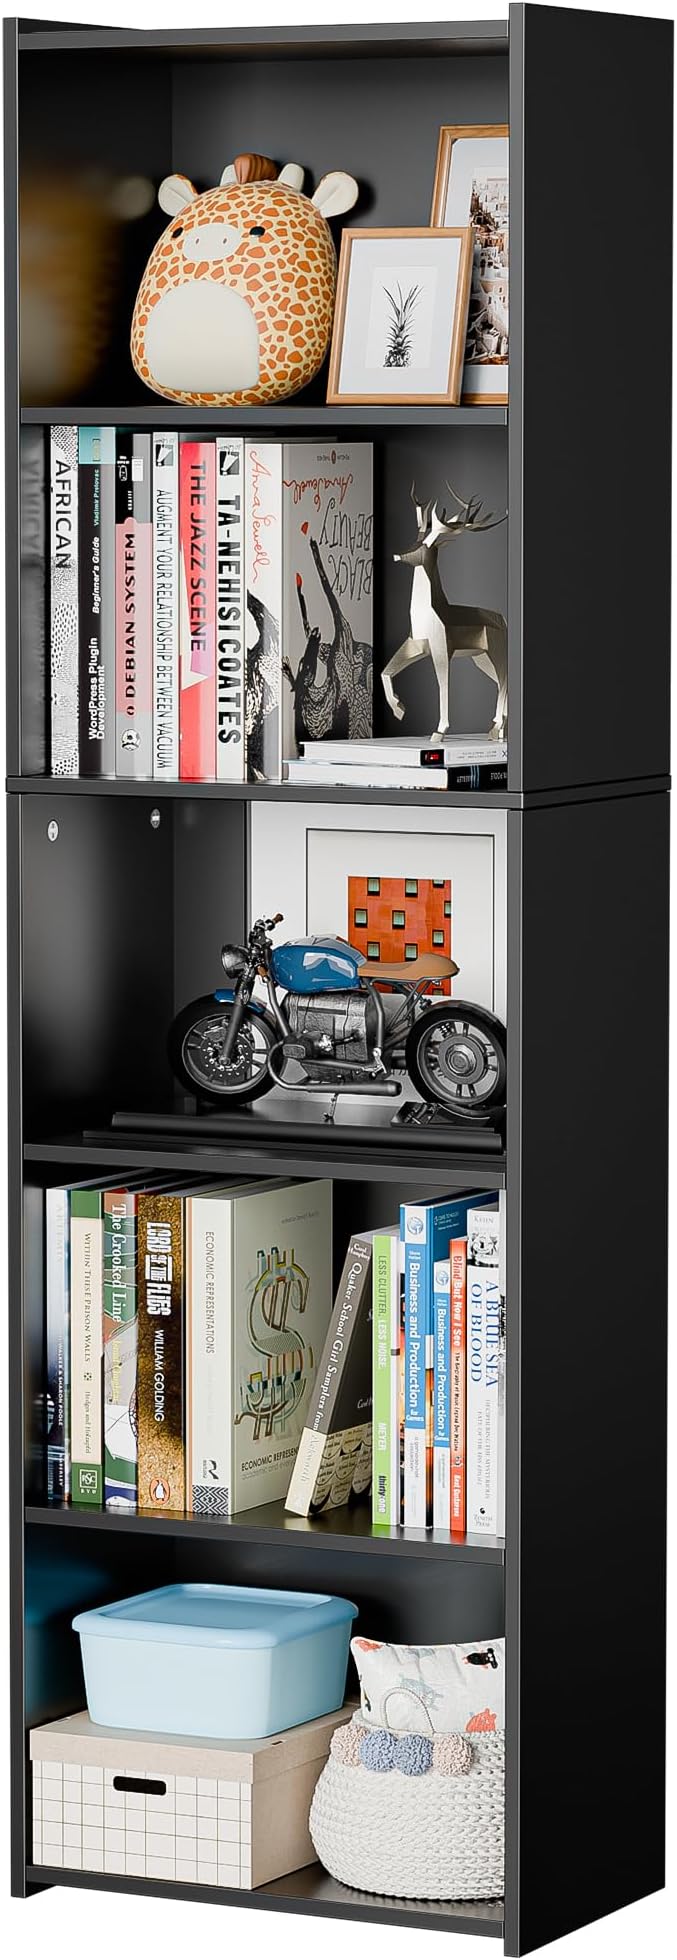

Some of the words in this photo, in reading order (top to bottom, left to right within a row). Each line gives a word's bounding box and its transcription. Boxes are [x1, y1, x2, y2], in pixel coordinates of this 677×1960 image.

[190, 461, 207, 507] THE
[55, 459, 72, 569] AFRICAN
[156, 489, 173, 545] AUGMENT
[319, 497, 374, 556] BEAUTY
[91, 536, 100, 563] Guide
[156, 547, 173, 579] YOUR
[190, 512, 207, 571] JAZZ
[91, 562, 101, 614] Beginner's
[125, 533, 137, 614] SYSTEM
[328, 554, 374, 601] BLACK
[156, 581, 173, 663] RELATIONSHIP
[190, 577, 207, 652] SCENE
[88, 637, 100, 674] Plugin
[125, 621, 137, 698] DEBIAN
[88, 677, 100, 740] WordPress
[97, 664, 105, 740] Development
[156, 665, 173, 719] BETWEEN
[218, 638, 241, 744] COATES
[156, 721, 173, 769] VACUUM
[111, 1203, 127, 1230] The
[84, 1232, 92, 1267] WITHIN
[111, 1233, 127, 1289] Crooked
[205, 1231, 215, 1279] ECONOMIC
[378, 1255, 387, 1276] LESS
[453, 1255, 462, 1280] Blind
[84, 1270, 92, 1298] THESE
[345, 1262, 363, 1299] Quaker
[410, 1263, 421, 1311] Business
[453, 1281, 462, 1299] But
[472, 1284, 482, 1309] OF
[485, 1280, 498, 1292] A
[84, 1299, 92, 1333] PRISON
[111, 1292, 127, 1322] Line
[205, 1281, 215, 1354] REPRESENTATIONS
[336, 1302, 353, 1337] School
[410, 1312, 421, 1340] and
[84, 1334, 92, 1362] WALLS
[154, 1330, 164, 1371] WILLIAM
[329, 1339, 345, 1362] Girl
[378, 1320, 387, 1341] LESS
[438, 1308, 447, 1351] Business
[453, 1328, 462, 1347] See
[471, 1315, 482, 1382] BLOOD
[409, 1342, 421, 1408] Production
[438, 1352, 447, 1371] and
[486, 1353, 499, 1387] SEA
[154, 1373, 165, 1422] GOLDING
[318, 1364, 338, 1411] Samplers
[437, 1373, 447, 1428] Production
[241, 1453, 273, 1472] ECONOMIC
